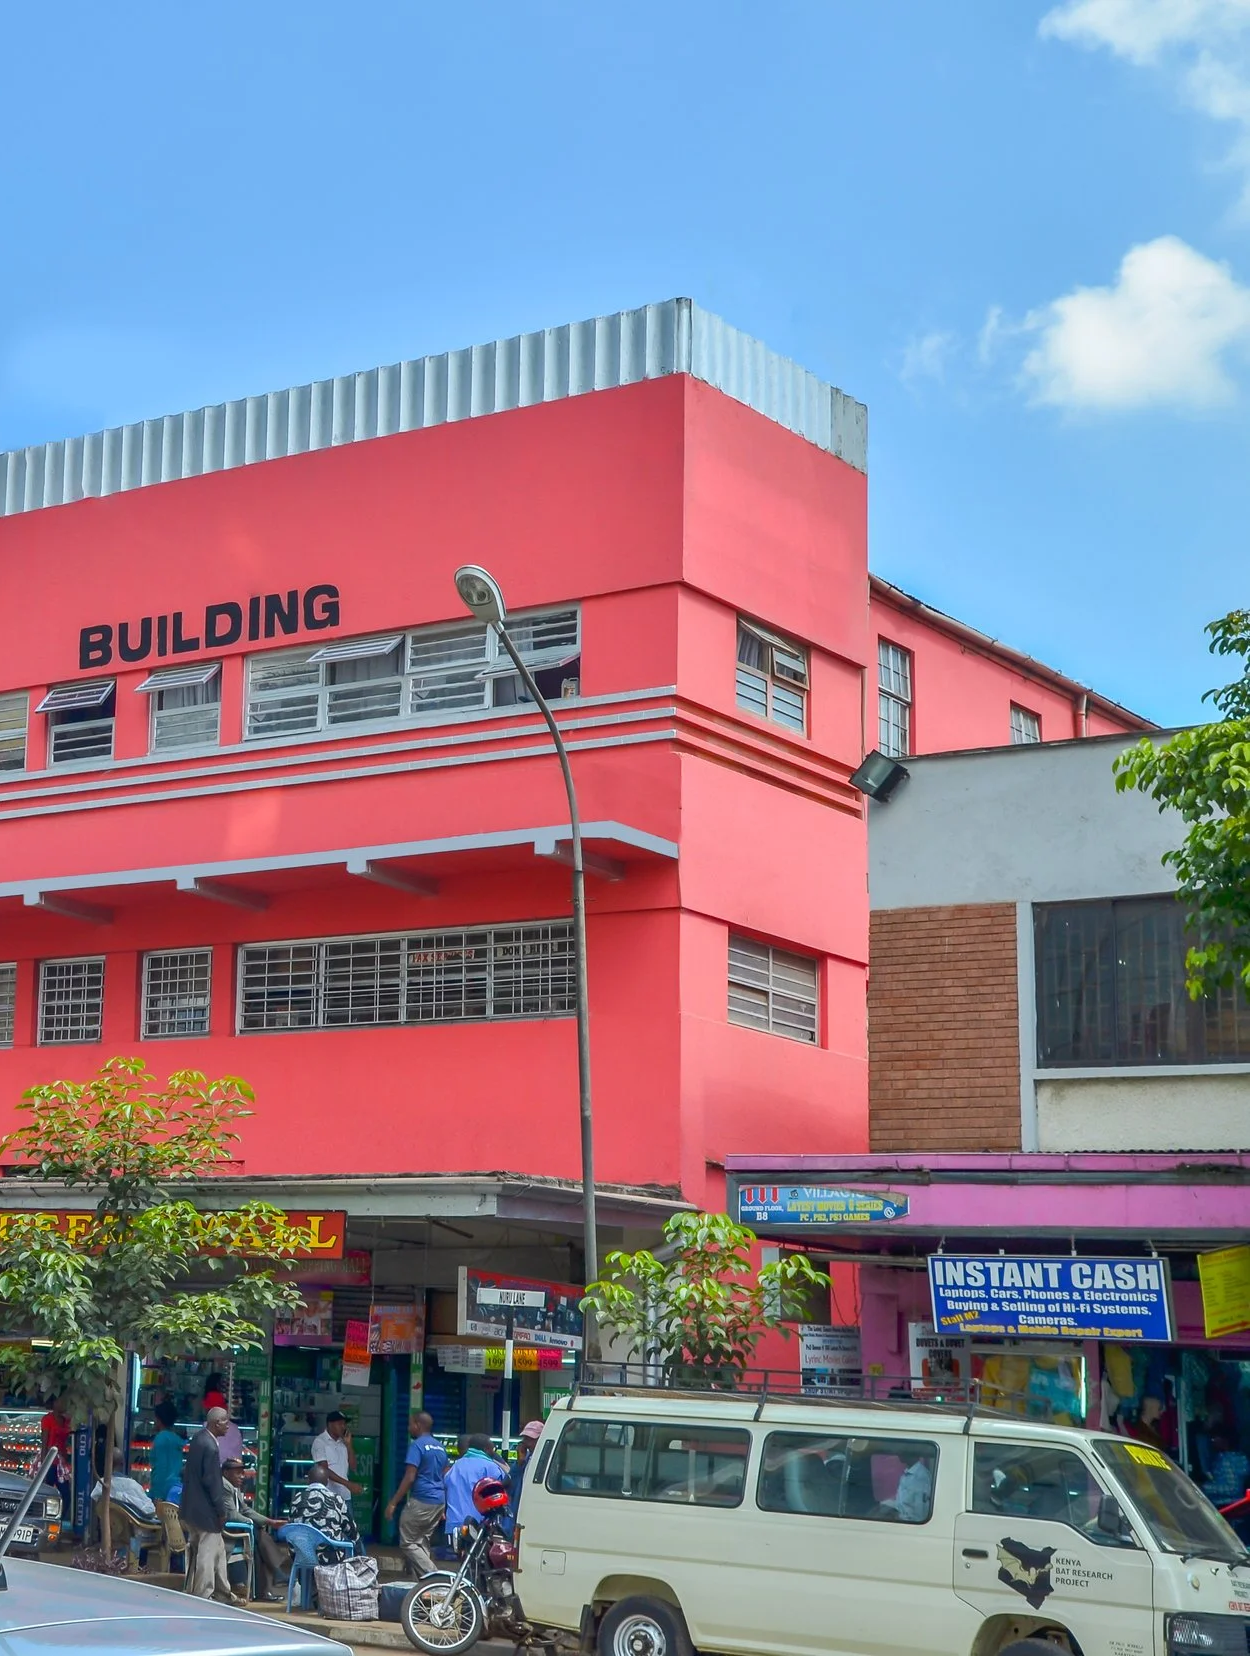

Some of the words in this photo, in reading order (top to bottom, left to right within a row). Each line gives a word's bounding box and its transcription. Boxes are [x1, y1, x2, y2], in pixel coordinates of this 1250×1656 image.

[78, 584, 340, 669] BUILDING
[786, 1201, 815, 1212] LATEST
[817, 1202, 846, 1212] MOVIES
[856, 1201, 884, 1212] SERIES
[756, 1212, 768, 1221] B8
[843, 1213, 870, 1222] GAMES
[934, 1261, 1062, 1288] INSTANT
[1070, 1263, 1160, 1290] CASH
[499, 1291, 512, 1304] NURU
[513, 1292, 526, 1305] LANE
[1023, 1289, 1070, 1300] Phones
[1072, 1290, 1082, 1300] &
[1083, 1290, 1158, 1302] Electronics
[946, 1300, 989, 1312] Buying
[990, 1301, 1000, 1311] &
[1001, 1301, 1045, 1313] Selling
[1047, 1303, 1061, 1312] of
[1062, 1303, 1091, 1313] Hi-Fi
[940, 1313, 965, 1326] Stall
[1018, 1314, 1078, 1326] Cameras.
[959, 1323, 1005, 1334] Laptops
[1018, 1325, 1059, 1335] Mobile
[1061, 1326, 1101, 1337] Repair
[1103, 1327, 1143, 1338] Expert
[1055, 1557, 1081, 1567] KENYA
[1055, 1567, 1070, 1576] BAT
[1071, 1569, 1113, 1581] RESEARCH
[1055, 1577, 1089, 1588] PROJECT
